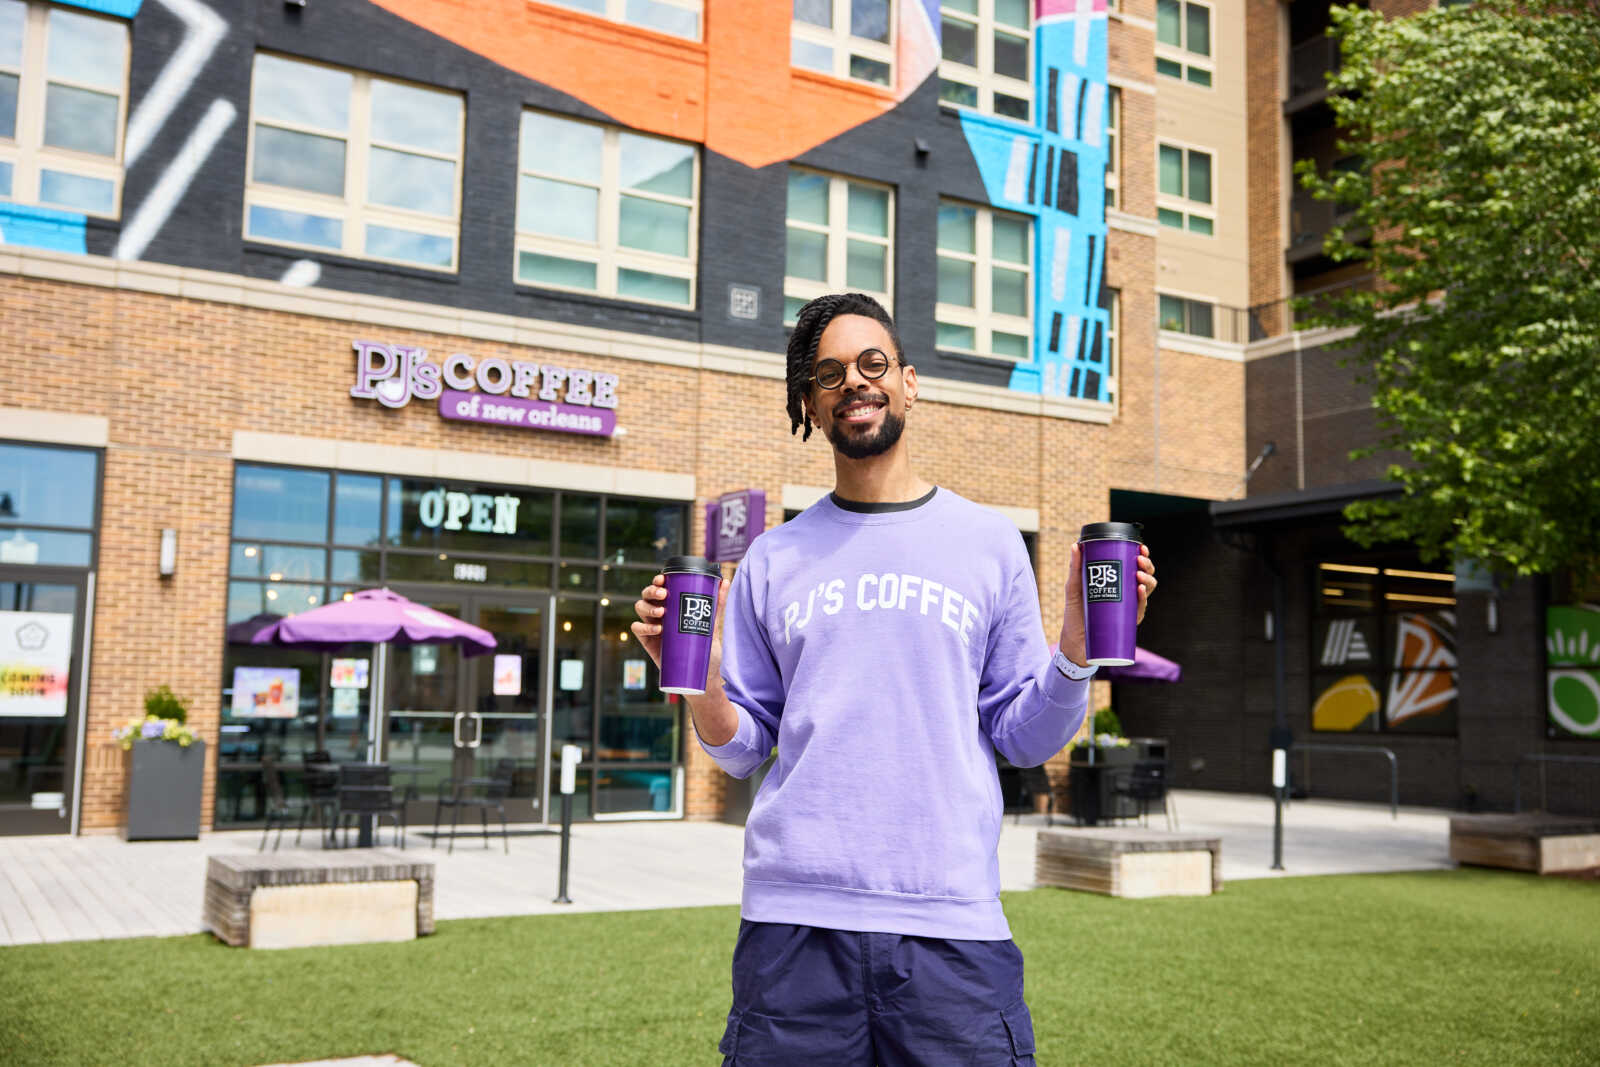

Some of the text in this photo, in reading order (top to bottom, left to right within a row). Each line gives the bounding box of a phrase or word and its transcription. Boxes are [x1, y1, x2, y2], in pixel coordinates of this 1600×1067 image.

[443, 353, 619, 408] COFFEE
[456, 395, 602, 432] of new orleans
[420, 489, 520, 534] OPEN
[683, 618, 709, 627] COFFEE
[784, 573, 980, 647] PJ'S COFFEE
